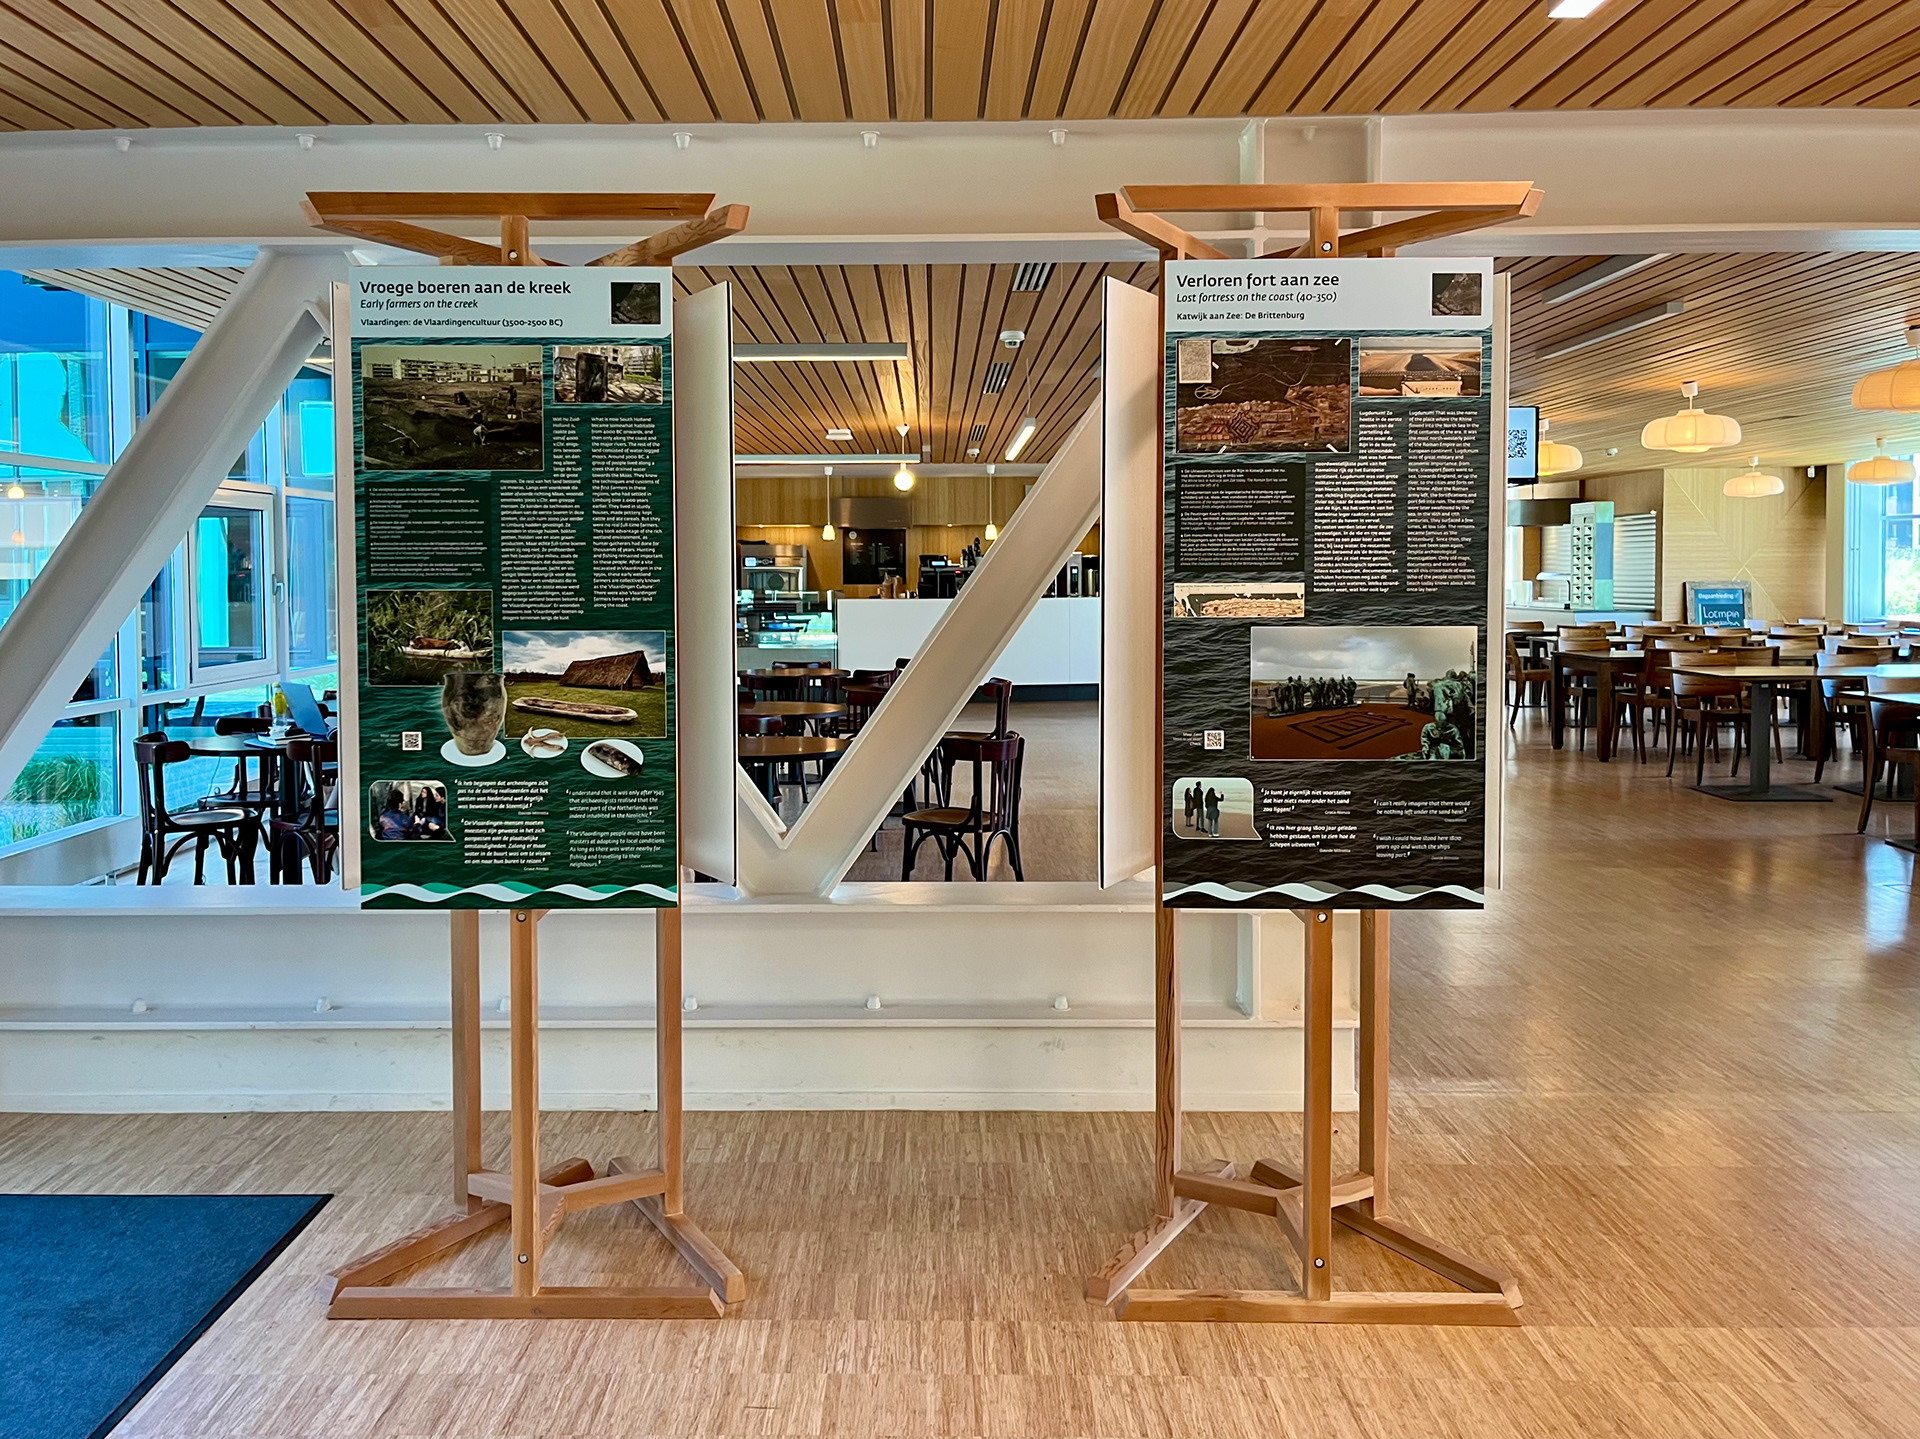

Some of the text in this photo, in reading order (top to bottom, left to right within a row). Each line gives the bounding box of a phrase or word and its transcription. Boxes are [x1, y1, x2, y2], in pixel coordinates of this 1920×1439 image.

[1176, 274, 1339, 289] Verloren fort aan zee
[360, 281, 571, 296] Vroege boeren aan de kreek
[1176, 293, 1196, 302] Lost
[1199, 292, 1235, 304] fortress
[1251, 292, 1266, 302] the
[1269, 292, 1294, 302] coast
[1296, 292, 1337, 303] (40-350)
[360, 299, 384, 310] Early
[386, 299, 421, 310] farmers
[437, 299, 452, 308] the
[454, 299, 478, 308] creek
[1176, 312, 1207, 321] Katwijk
[1258, 312, 1304, 320] Brittenburg
[361, 319, 411, 327] Vlaardingen:
[424, 319, 501, 327] Vlaardingencultuur
[502, 319, 547, 327] (3500-2500
[549, 319, 563, 327] BC)
